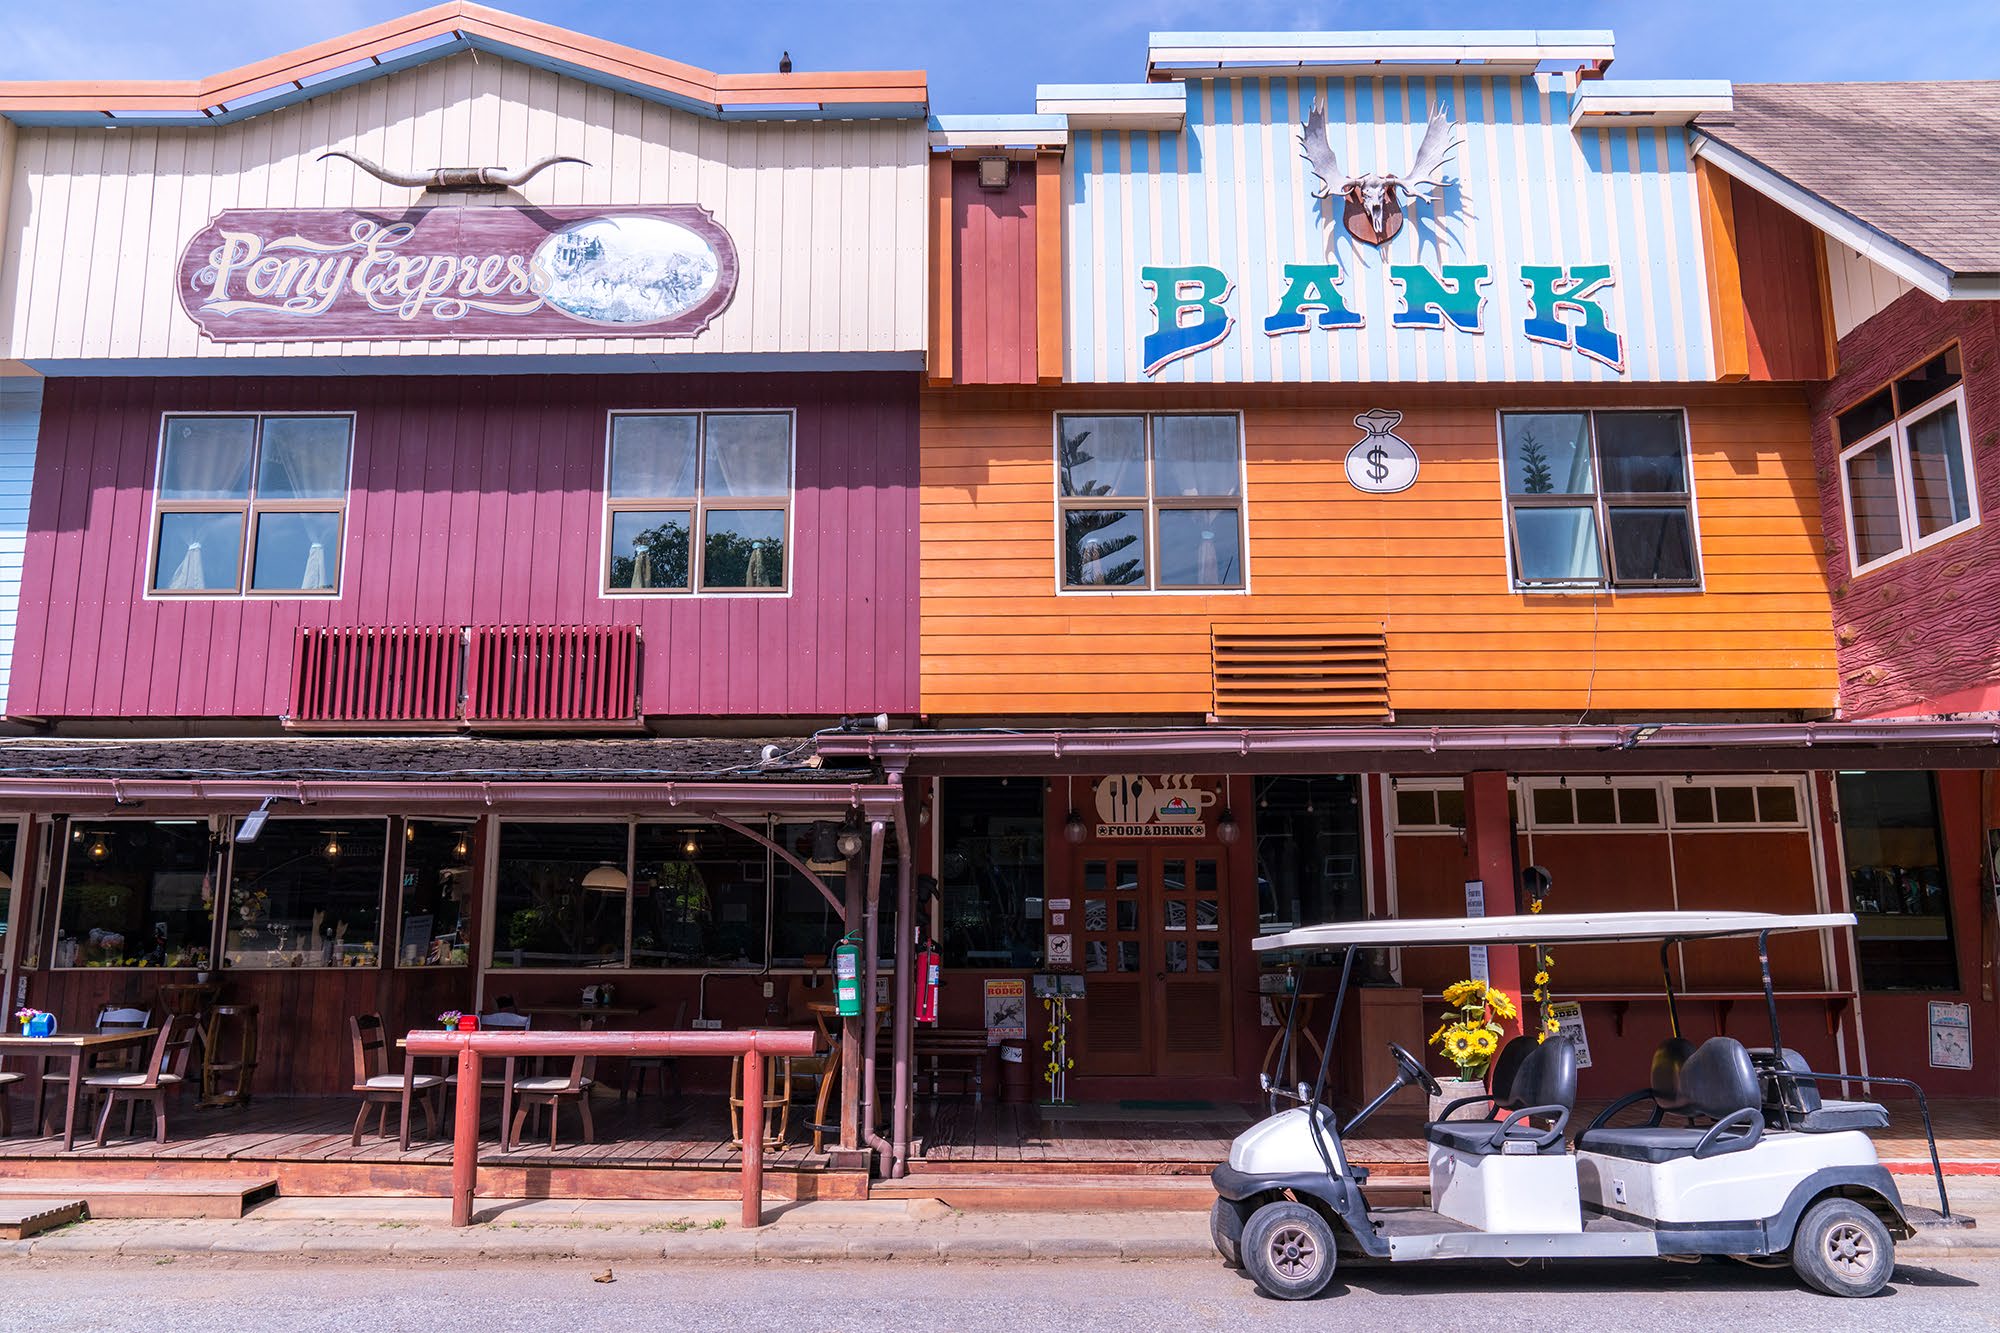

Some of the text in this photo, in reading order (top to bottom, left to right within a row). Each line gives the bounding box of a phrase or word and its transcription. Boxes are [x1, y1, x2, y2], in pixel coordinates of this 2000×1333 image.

[192, 219, 553, 321] Pony Express
[1141, 264, 1625, 377] BANK
[1366, 444, 1389, 484] $
[988, 987, 1023, 995] RODEO
